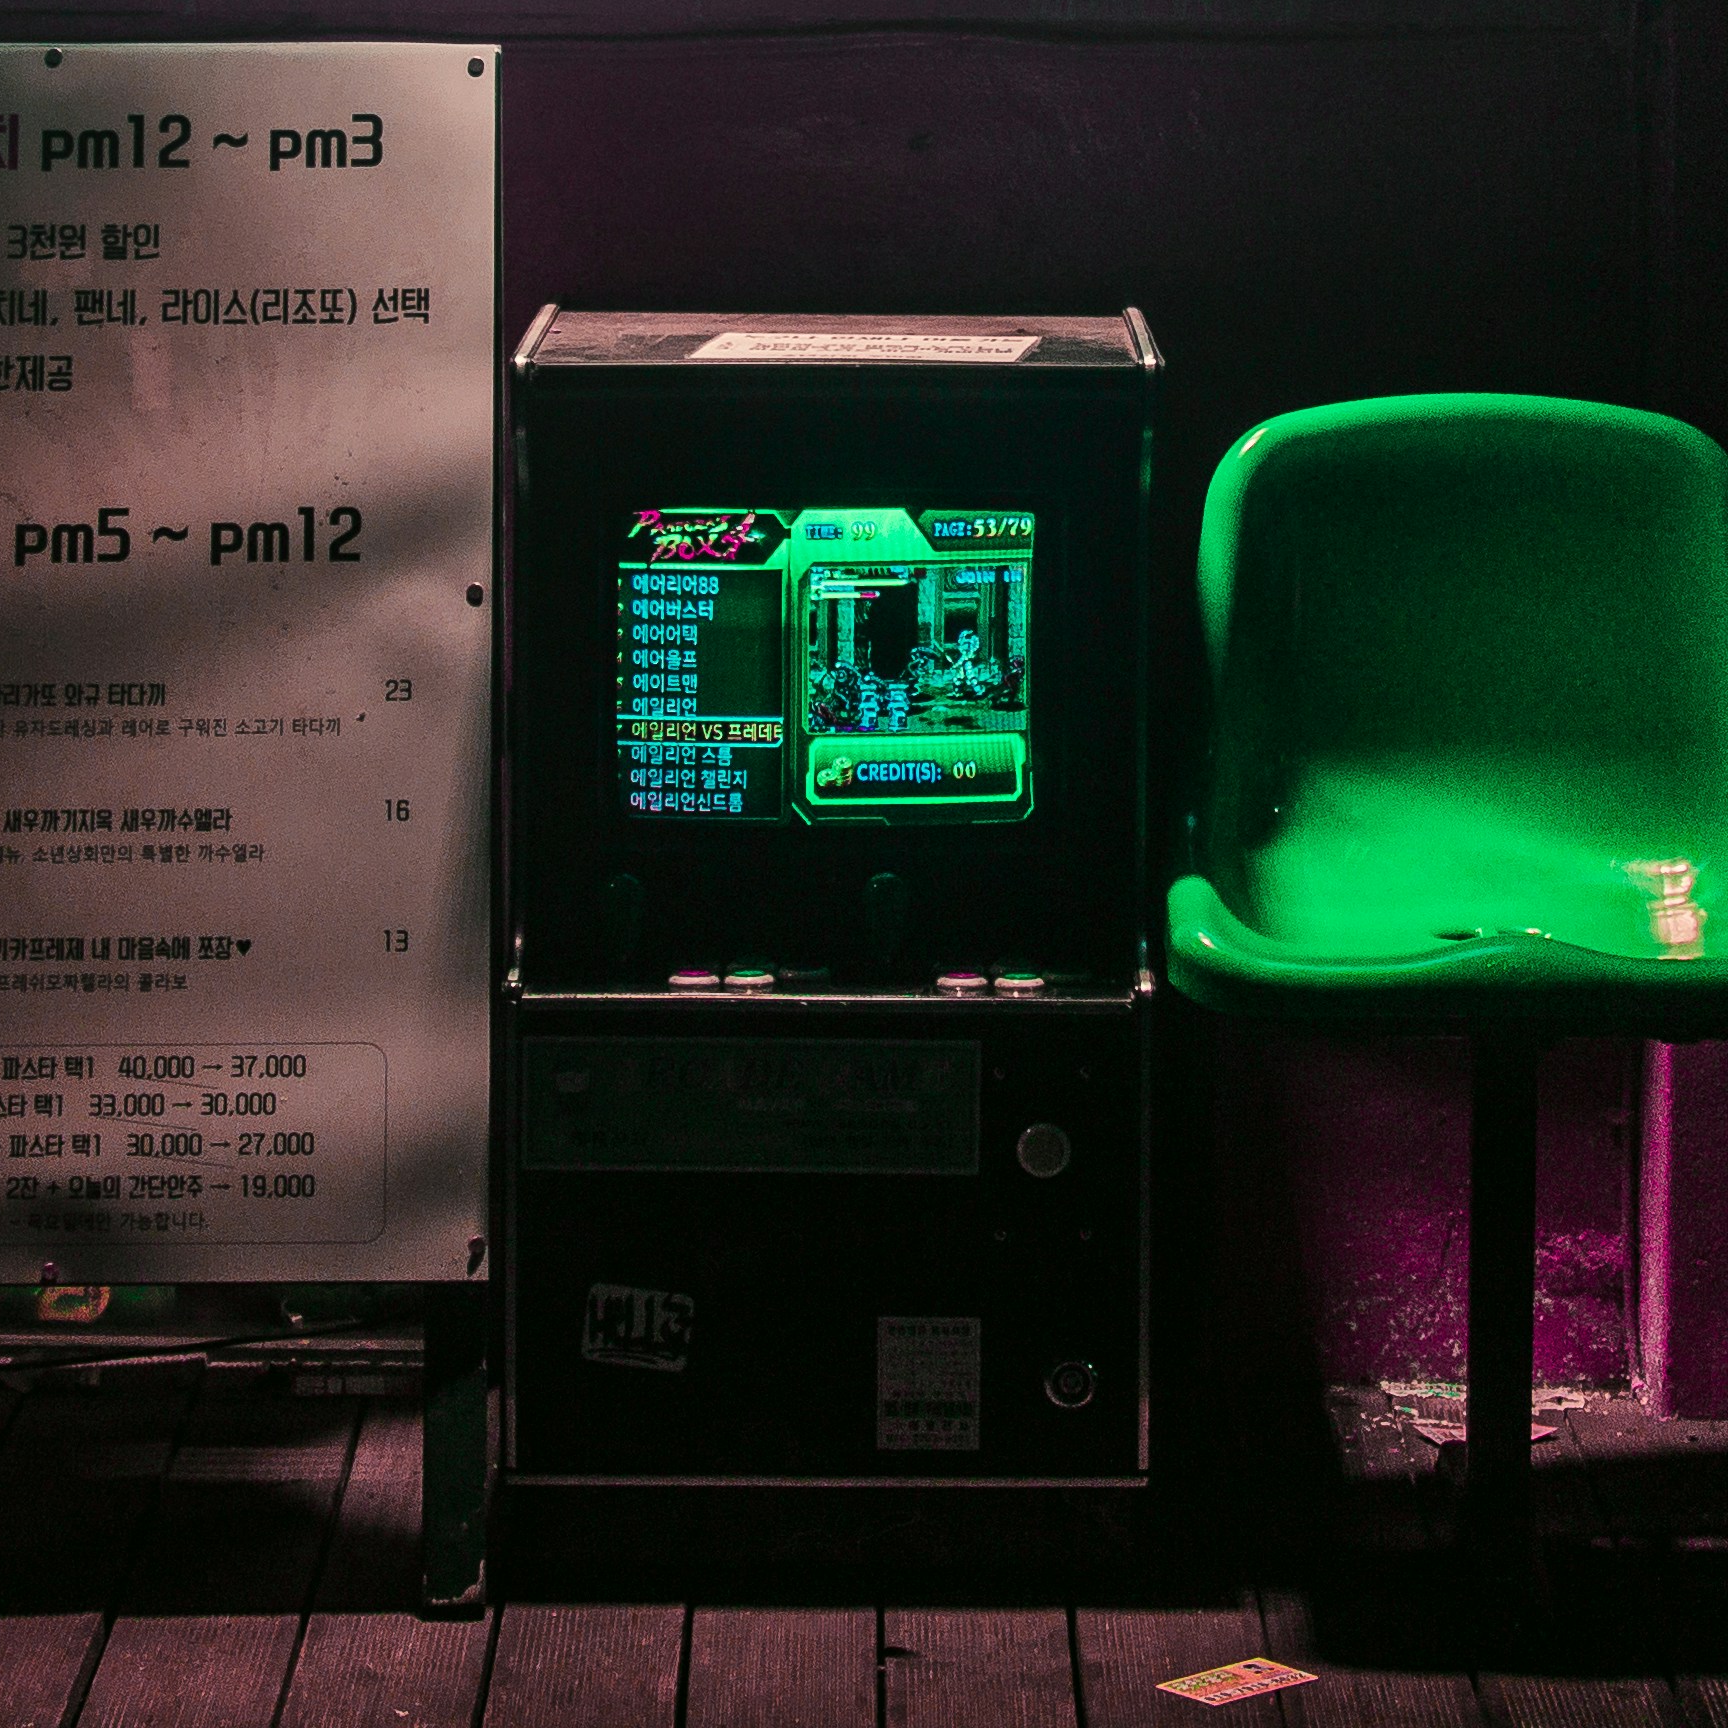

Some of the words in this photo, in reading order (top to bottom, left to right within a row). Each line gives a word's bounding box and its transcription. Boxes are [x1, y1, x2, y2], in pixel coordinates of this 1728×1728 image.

[42, 114, 190, 172] pm12
[271, 113, 383, 172] pm3
[8, 224, 87, 261] 3천원
[101, 223, 160, 260] 할인
[161, 288, 358, 326] 라이스(리조또)
[372, 286, 429, 325] 선택
[15, 508, 130, 567] pm5
[211, 506, 362, 565] pm12
[851, 522, 875, 539] 99
[632, 574, 719, 596] 에어리어88
[632, 599, 714, 621] 에어버스터
[632, 624, 698, 645] 에어어택
[632, 649, 698, 669] 에어울프
[65, 683, 102, 707] 와규
[108, 682, 165, 707] 타다끼
[385, 680, 413, 702] 23
[632, 674, 698, 693] 에이트맨
[632, 698, 698, 716] 에일리언
[122, 719, 170, 737] 레어로
[178, 718, 227, 737] 구워진
[234, 717, 285, 737] 소고기
[291, 717, 342, 737] 타다끼
[631, 722, 697, 741] 에일리언
[702, 725, 723, 740] VS
[631, 745, 697, 765] 에일리언
[630, 768, 696, 789] 에일리언
[701, 770, 747, 790] 챌린지
[856, 762, 941, 783] CREDIT(S):
[953, 764, 976, 780] 00
[384, 795, 411, 822] 16
[630, 792, 743, 813] 에일리언신드롬
[3, 808, 113, 834] 새우까기지옥
[120, 808, 232, 833] 새우까수엘라
[33, 845, 133, 863] 소년상회만의
[140, 844, 190, 862] 특별한
[198, 843, 263, 862] 까수엘라
[92, 937, 111, 960] 내
[118, 937, 190, 960] 마음속에
[383, 929, 410, 953] 13
[2, 1057, 57, 1080] 파스타
[65, 1056, 94, 1080] 택1
[118, 1056, 194, 1082] 40,000
[231, 1055, 306, 1081] 37,000
[34, 1095, 63, 1118] 택1
[89, 1095, 164, 1119] 33,000
[201, 1093, 276, 1118] 30,000
[9, 1136, 65, 1159] 파스타
[72, 1135, 100, 1159] 택1
[127, 1134, 201, 1160] 30,000
[238, 1133, 314, 1159] 27,000
[6, 1176, 41, 1200] 2잔
[68, 1176, 120, 1200] 오늘의
[128, 1175, 203, 1200] 간단안주
[241, 1174, 315, 1200] 19,000
